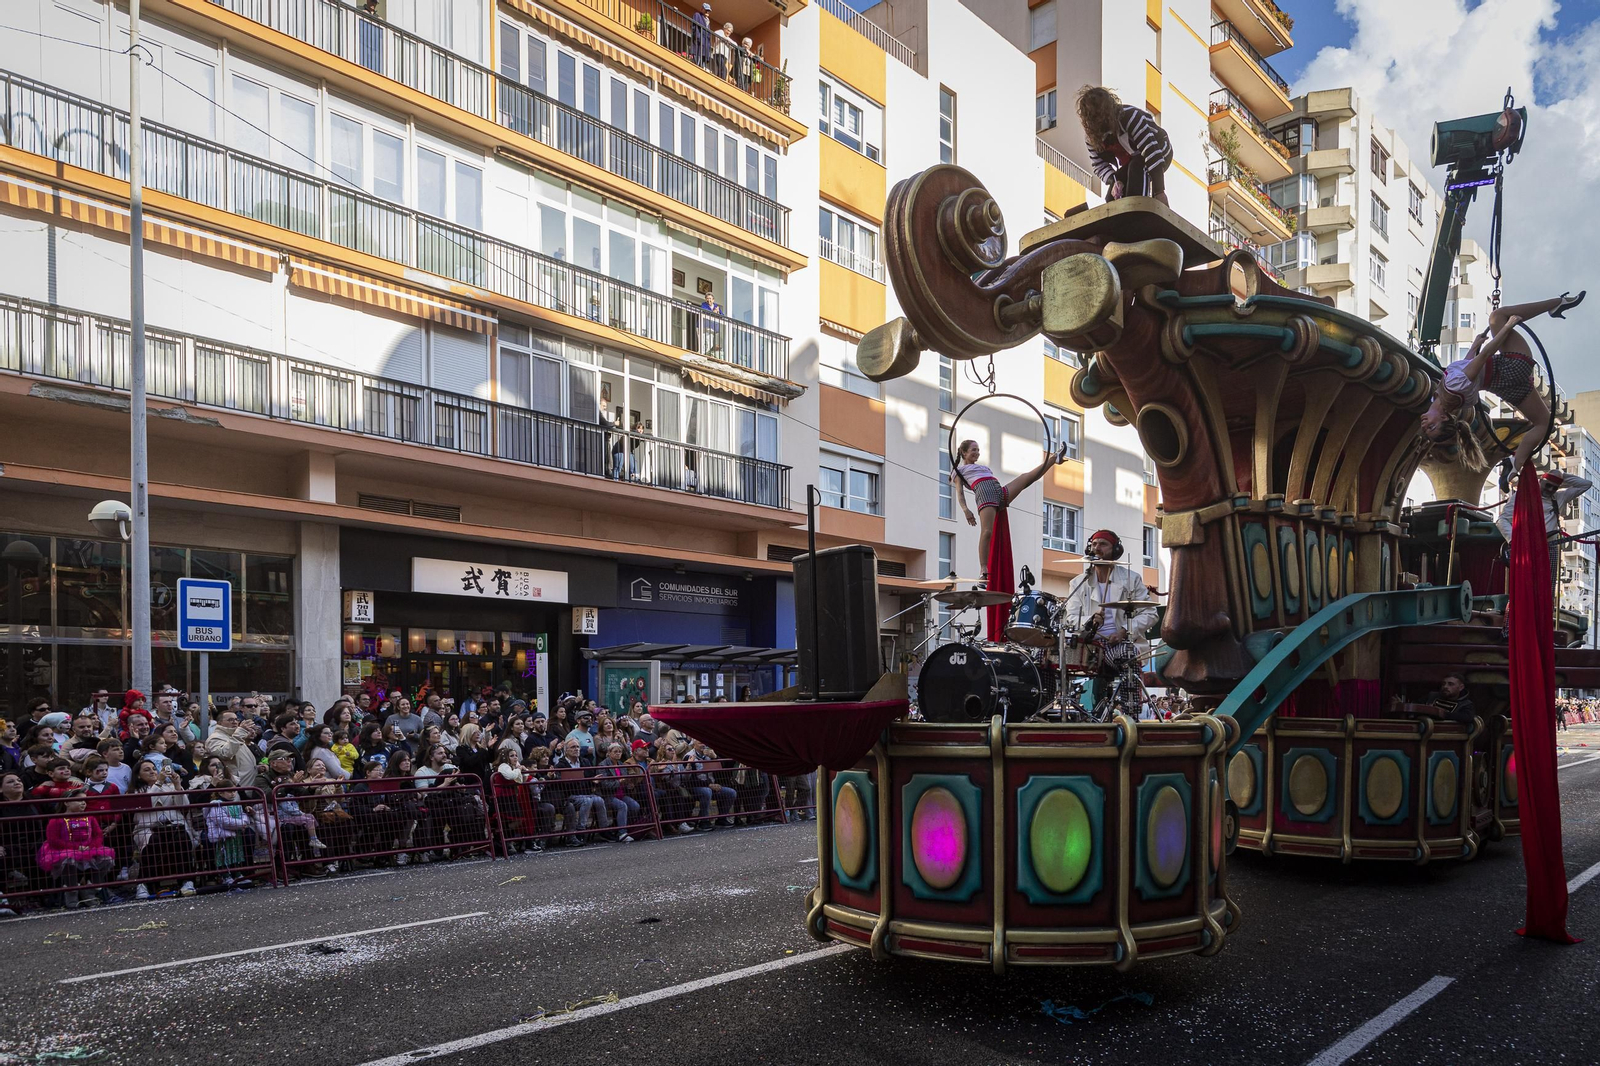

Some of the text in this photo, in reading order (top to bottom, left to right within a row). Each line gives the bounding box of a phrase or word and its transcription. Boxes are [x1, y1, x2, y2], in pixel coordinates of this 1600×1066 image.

[461, 566, 512, 596] 武賀
[659, 582, 738, 596] COMUNIDADES DEL SUR
[356, 592, 369, 616] 武賀
[659, 593, 738, 606] SERVICIOS INMOBILIARIOS
[188, 634, 222, 642] URBANO
